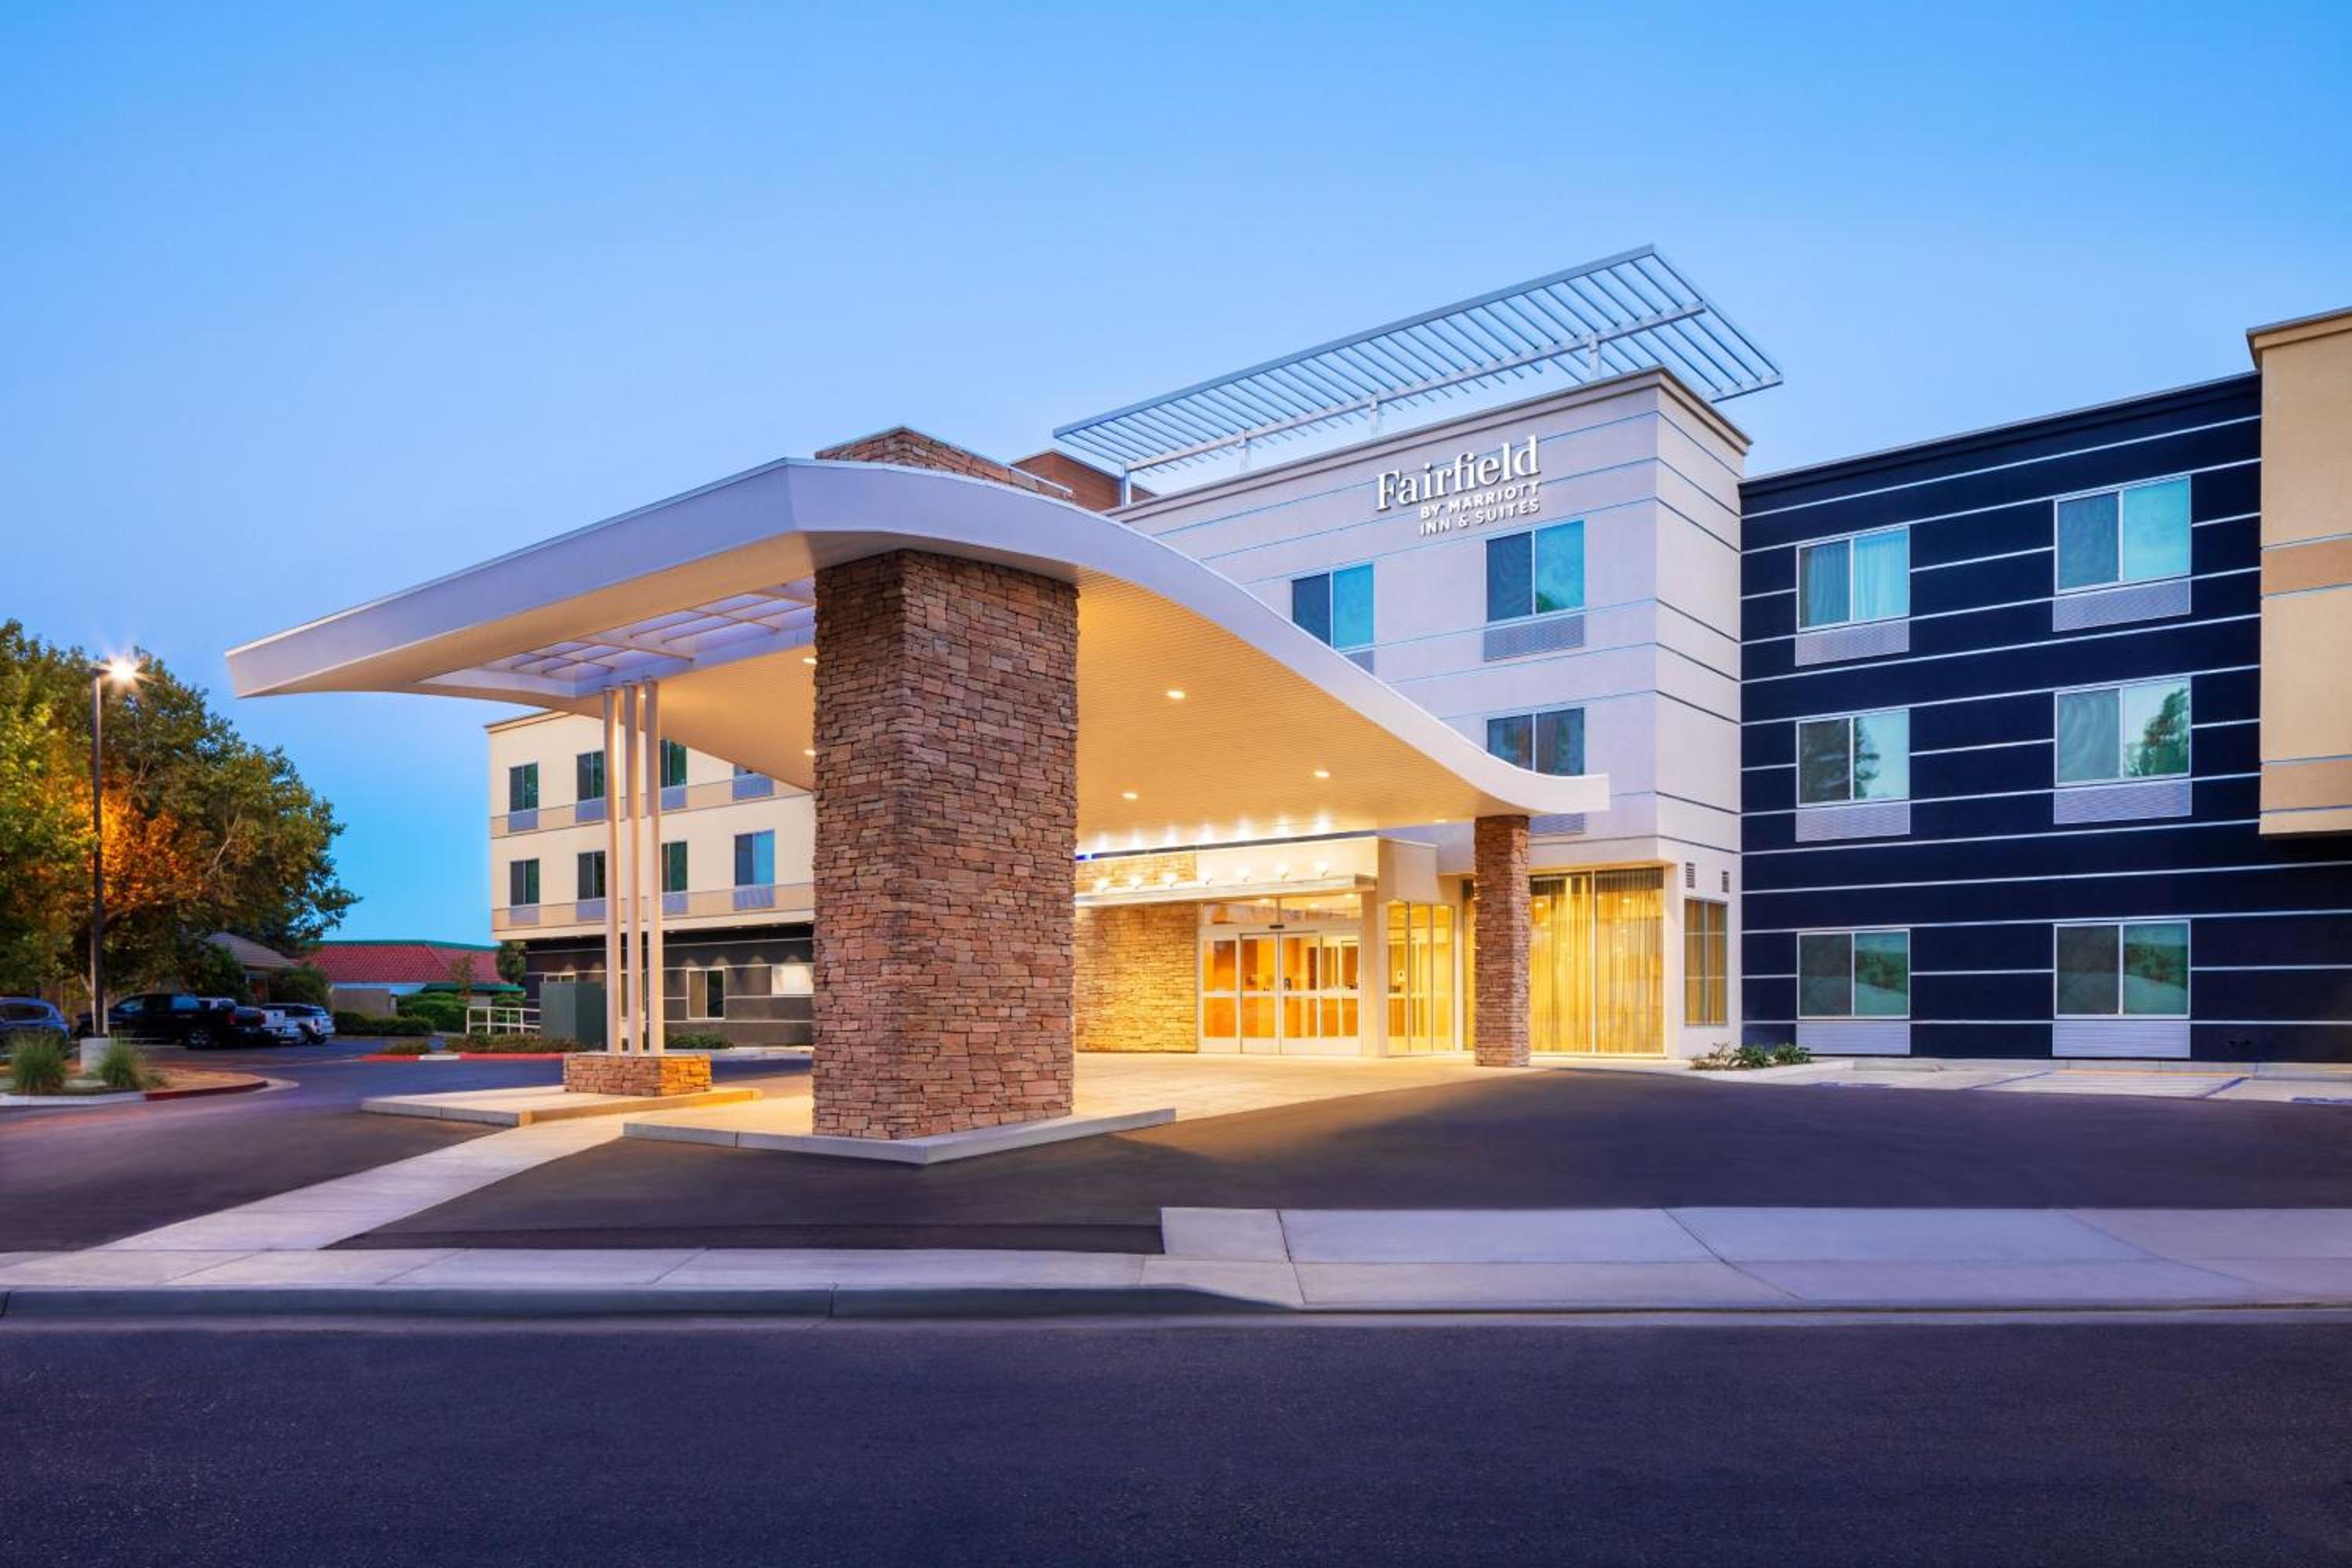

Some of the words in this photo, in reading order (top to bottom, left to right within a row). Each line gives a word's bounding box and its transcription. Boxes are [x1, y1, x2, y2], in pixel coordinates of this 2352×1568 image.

[1377, 434, 1540, 511] Fairfield
[1420, 504, 1443, 519] BY
[1449, 481, 1541, 514] MARRIOTT
[1420, 518, 1450, 535] INN
[1458, 517, 1470, 528] &
[1476, 498, 1541, 524] SUITES
